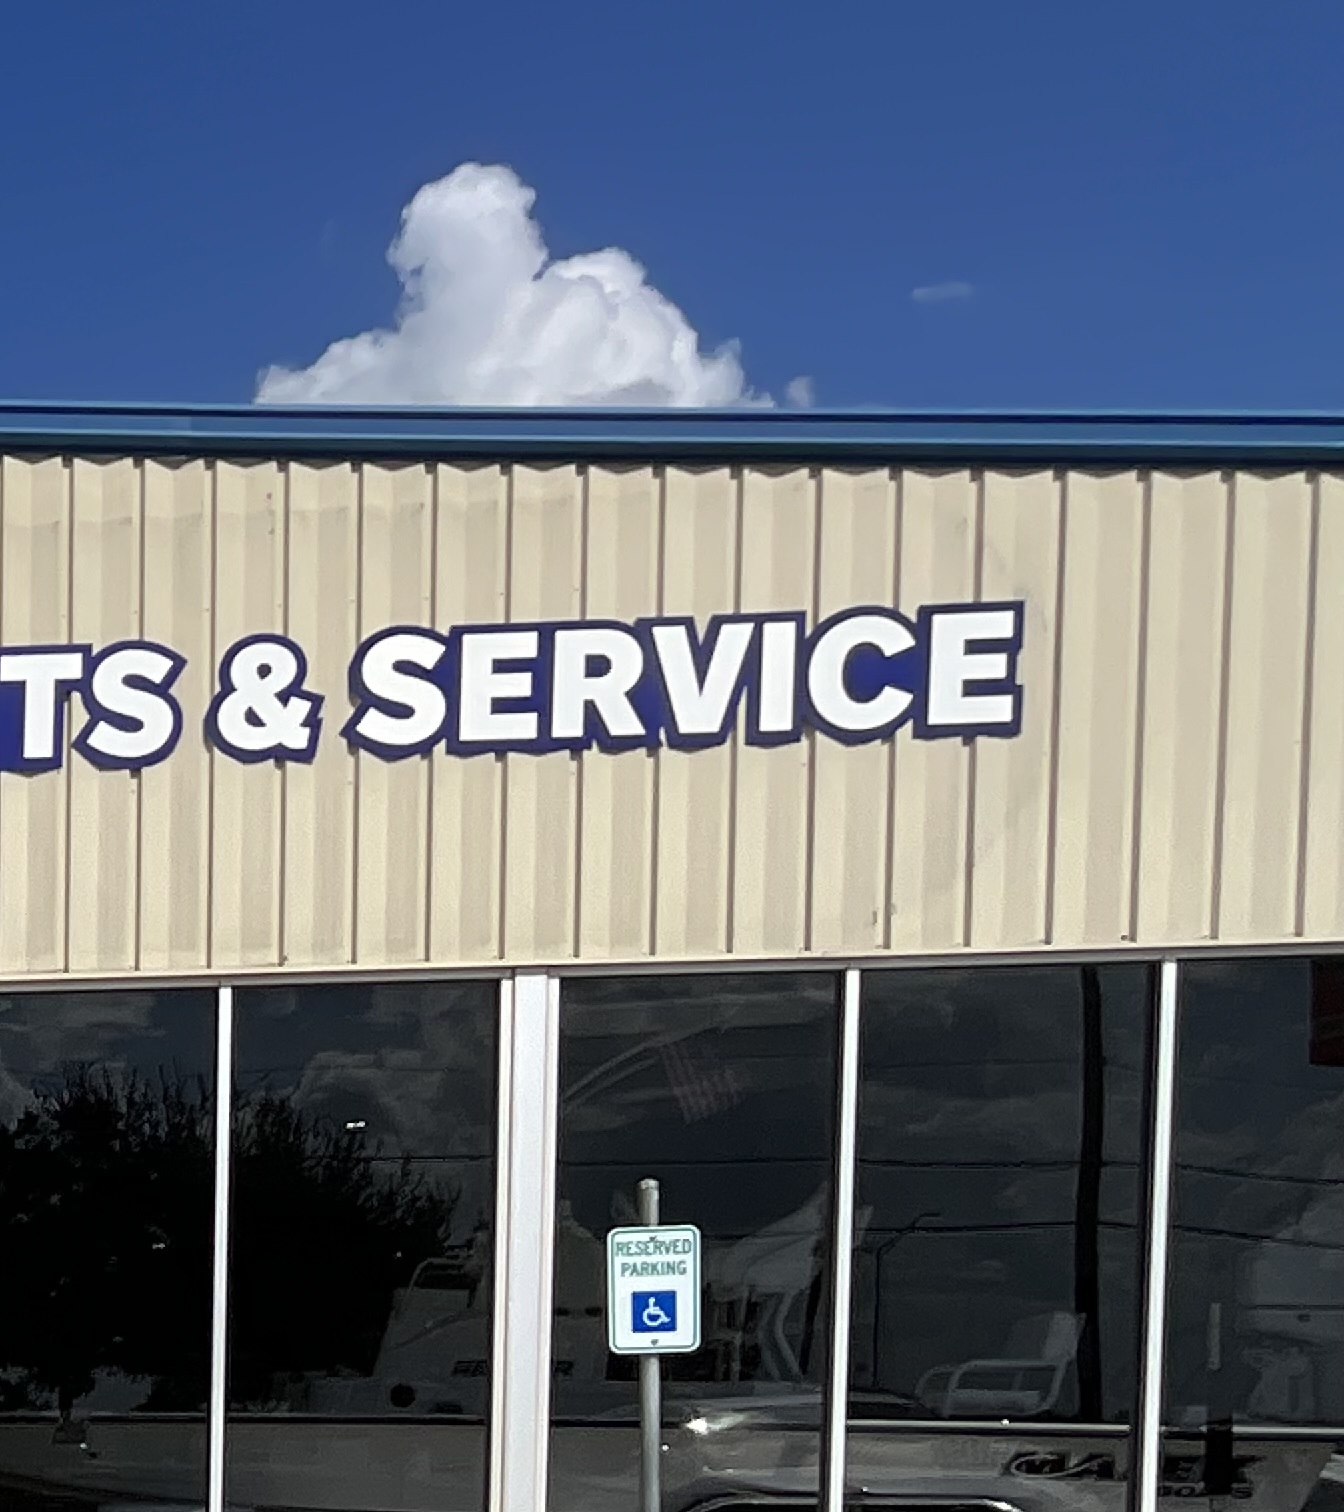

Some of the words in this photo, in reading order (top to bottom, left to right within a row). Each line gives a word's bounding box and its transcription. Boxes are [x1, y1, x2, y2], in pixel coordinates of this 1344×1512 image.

[216, 641, 313, 751] &
[353, 611, 1015, 747] SERVICE
[615, 1238, 692, 1257] RESERVED
[620, 1260, 687, 1278] PARKING
